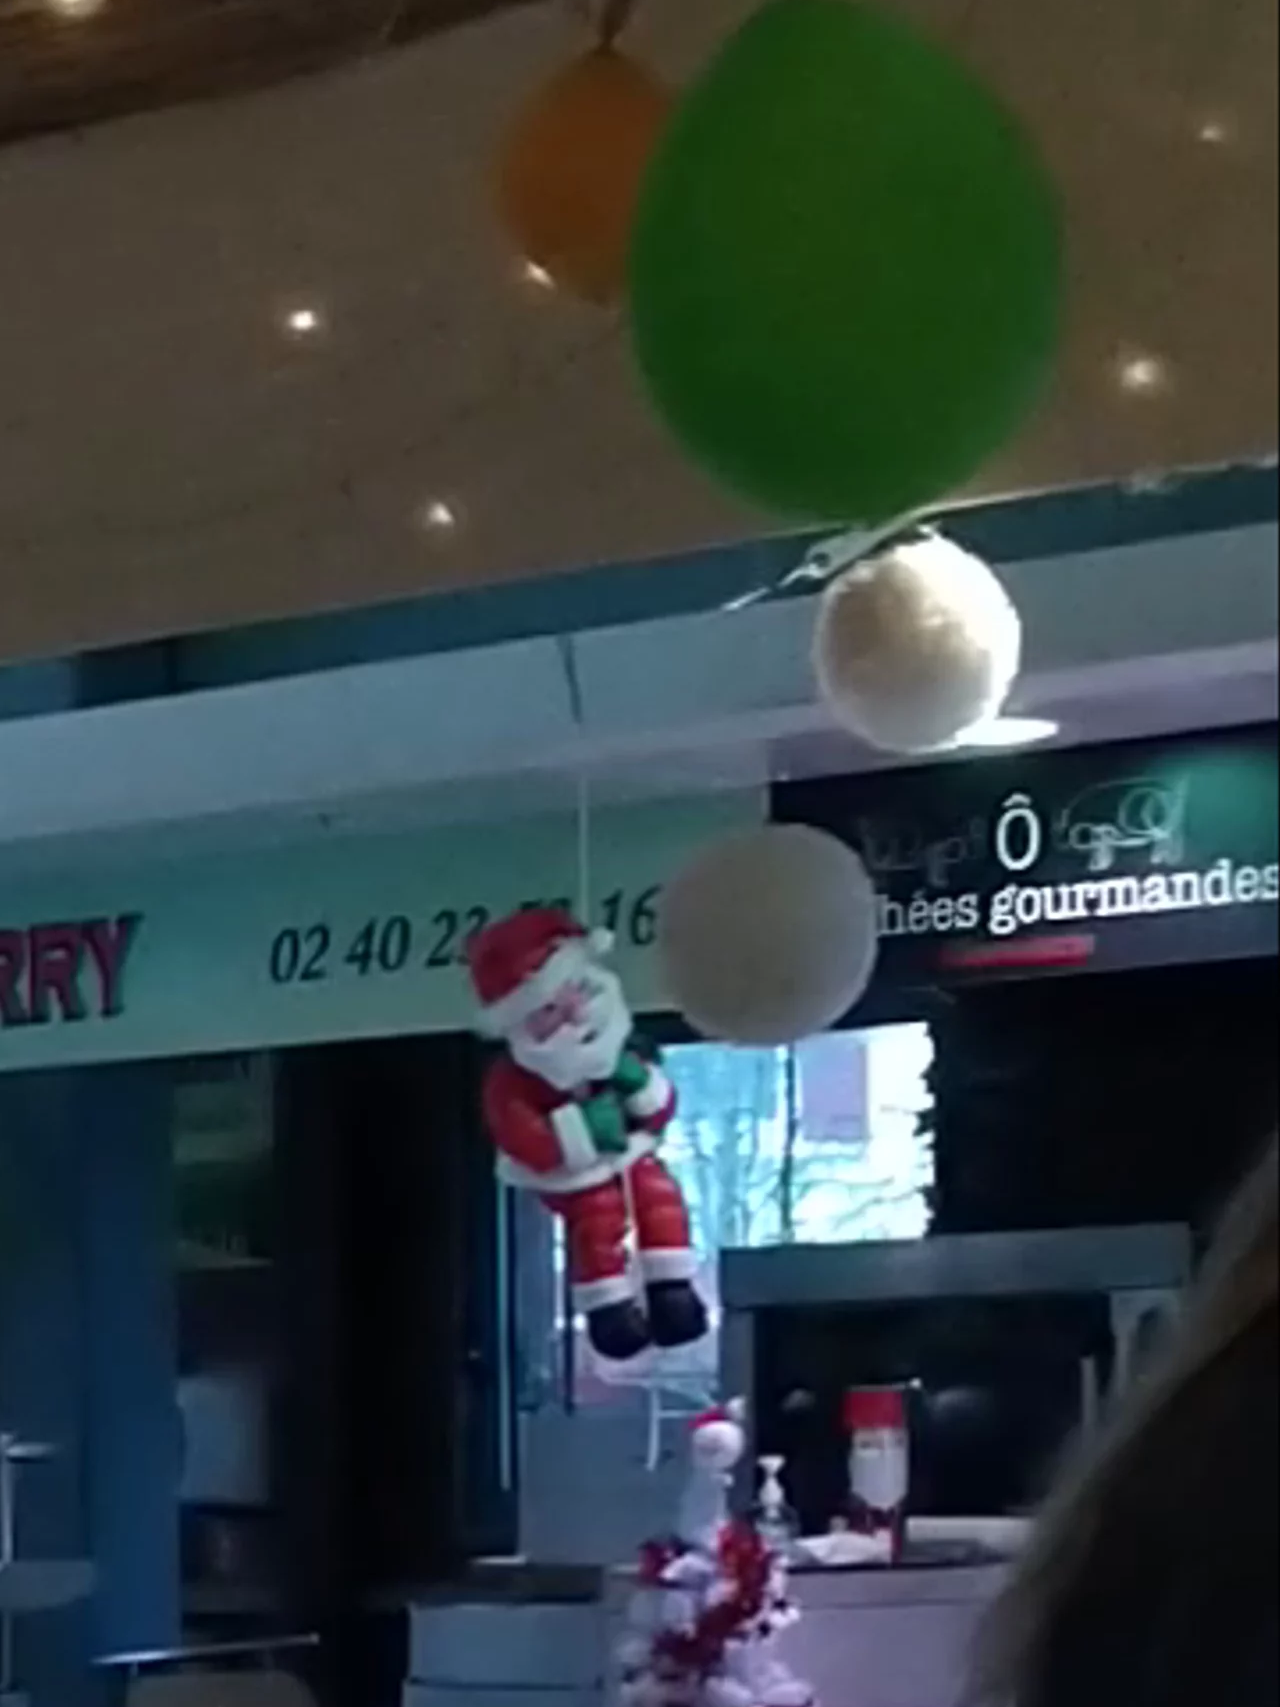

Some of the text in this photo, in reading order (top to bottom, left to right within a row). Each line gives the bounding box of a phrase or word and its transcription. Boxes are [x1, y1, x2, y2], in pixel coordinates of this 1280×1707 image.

[269, 925, 332, 985] 02
[344, 914, 412, 977] 40
[600, 883, 665, 946] 16
[987, 856, 1279, 936] gourmandes
